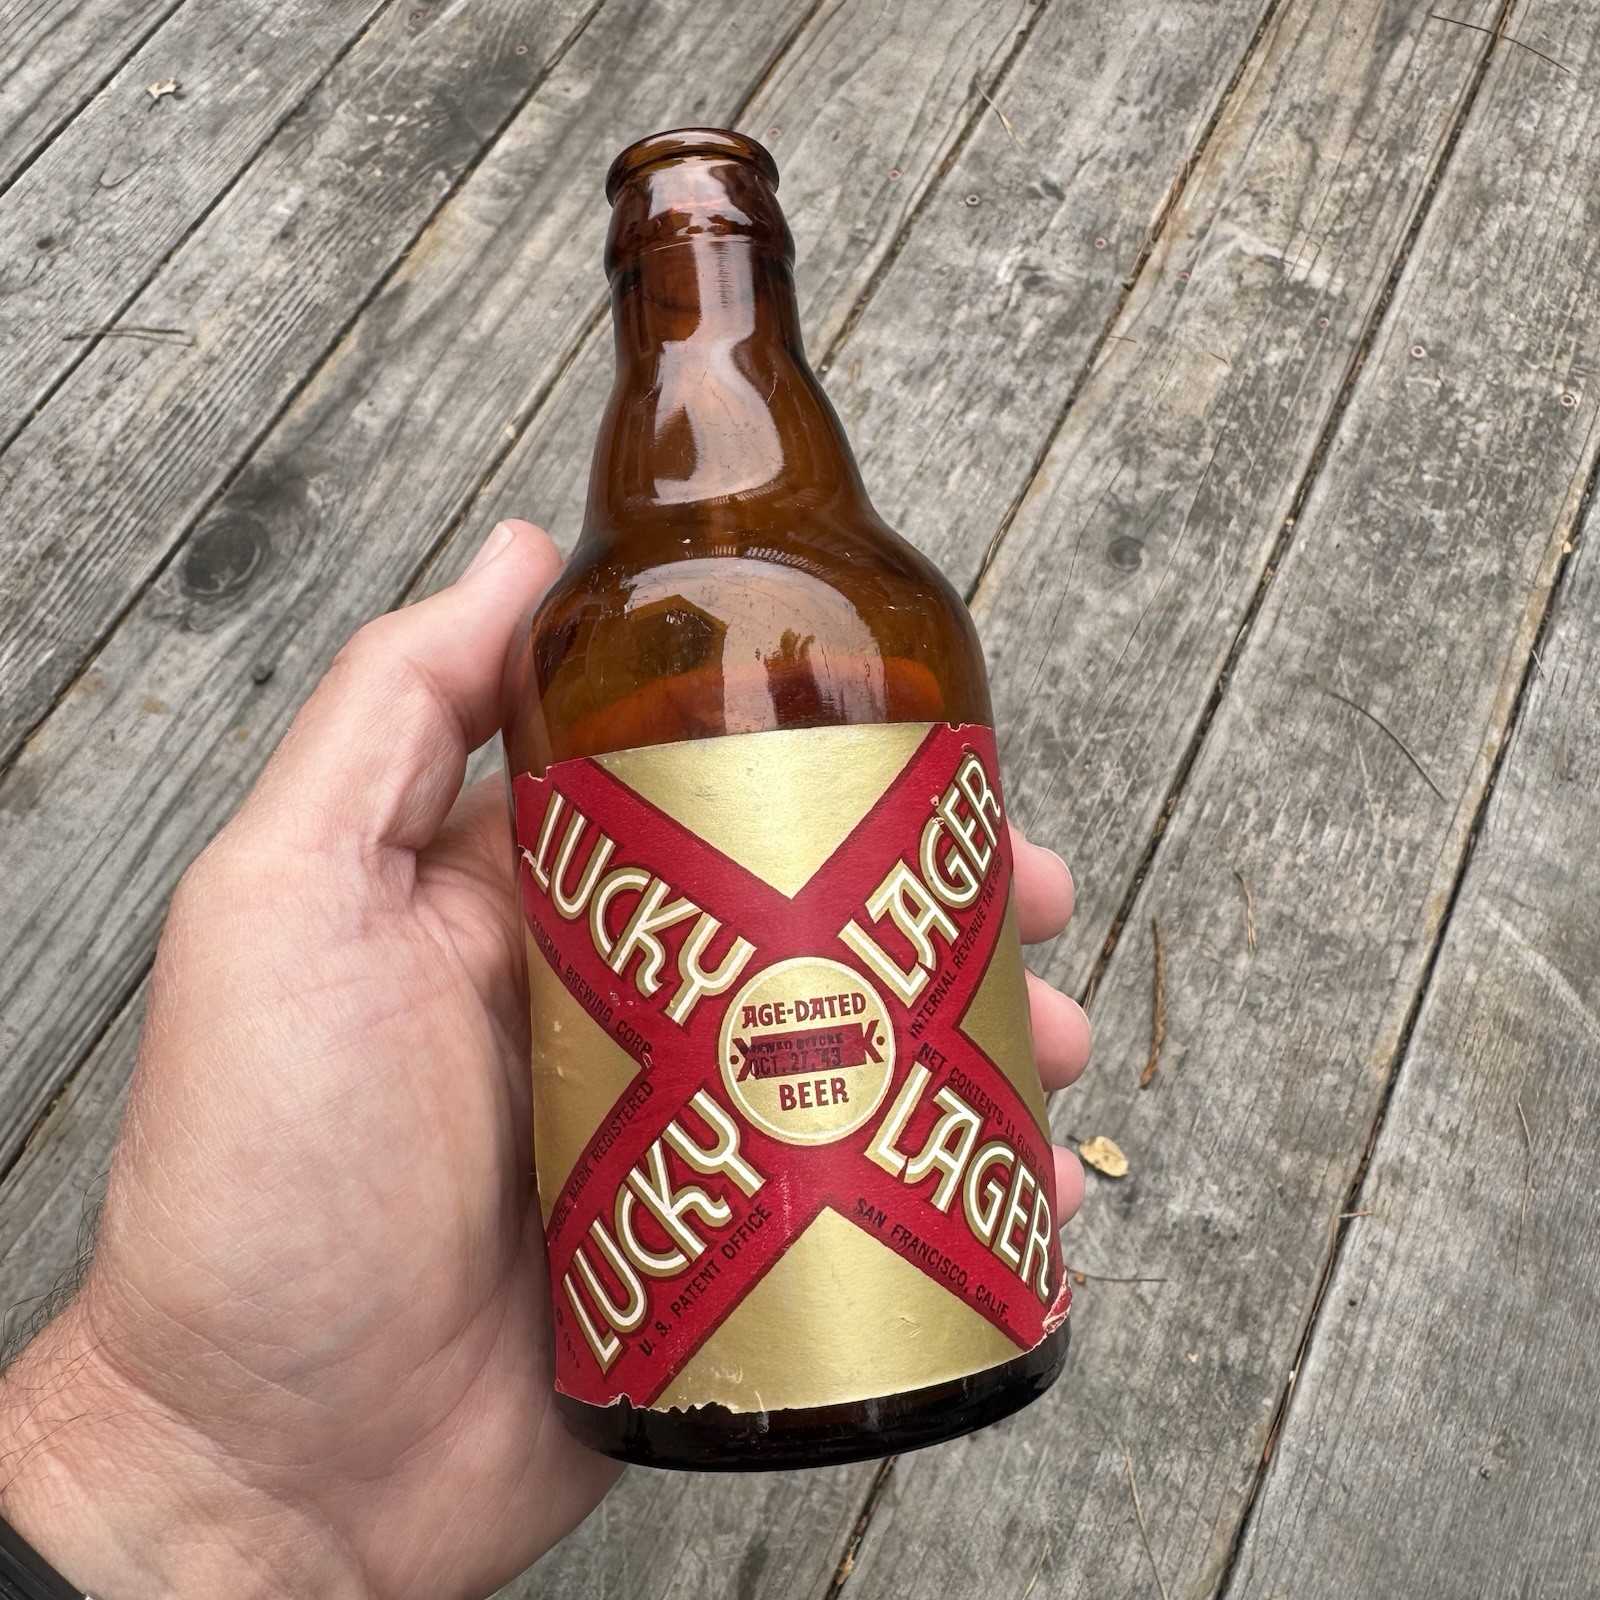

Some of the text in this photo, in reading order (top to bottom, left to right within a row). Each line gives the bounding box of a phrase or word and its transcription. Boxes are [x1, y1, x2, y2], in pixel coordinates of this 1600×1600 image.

[530, 790, 757, 1027] LUCKY
[838, 753, 1003, 1008] LAGER
[565, 964, 614, 1022] BREWING
[741, 993, 867, 1029] AGE-DATED
[908, 969, 957, 1039] INTERNAL
[954, 910, 987, 969] REVENUE
[749, 1055, 787, 1079] OCT.
[779, 1077, 849, 1112] BEER
[917, 1042, 948, 1072] NET
[948, 1067, 1004, 1126] CONTENTS
[568, 1161, 594, 1201] MARK
[591, 1080, 655, 1164] REGISTERED
[864, 1061, 1053, 1304] LAGER
[561, 1088, 767, 1376] LUCKY
[637, 1204, 772, 1357] U. S. PATENT OFFICE
[852, 1198, 1011, 1324] SAN FRANCISCO, CALIF.
